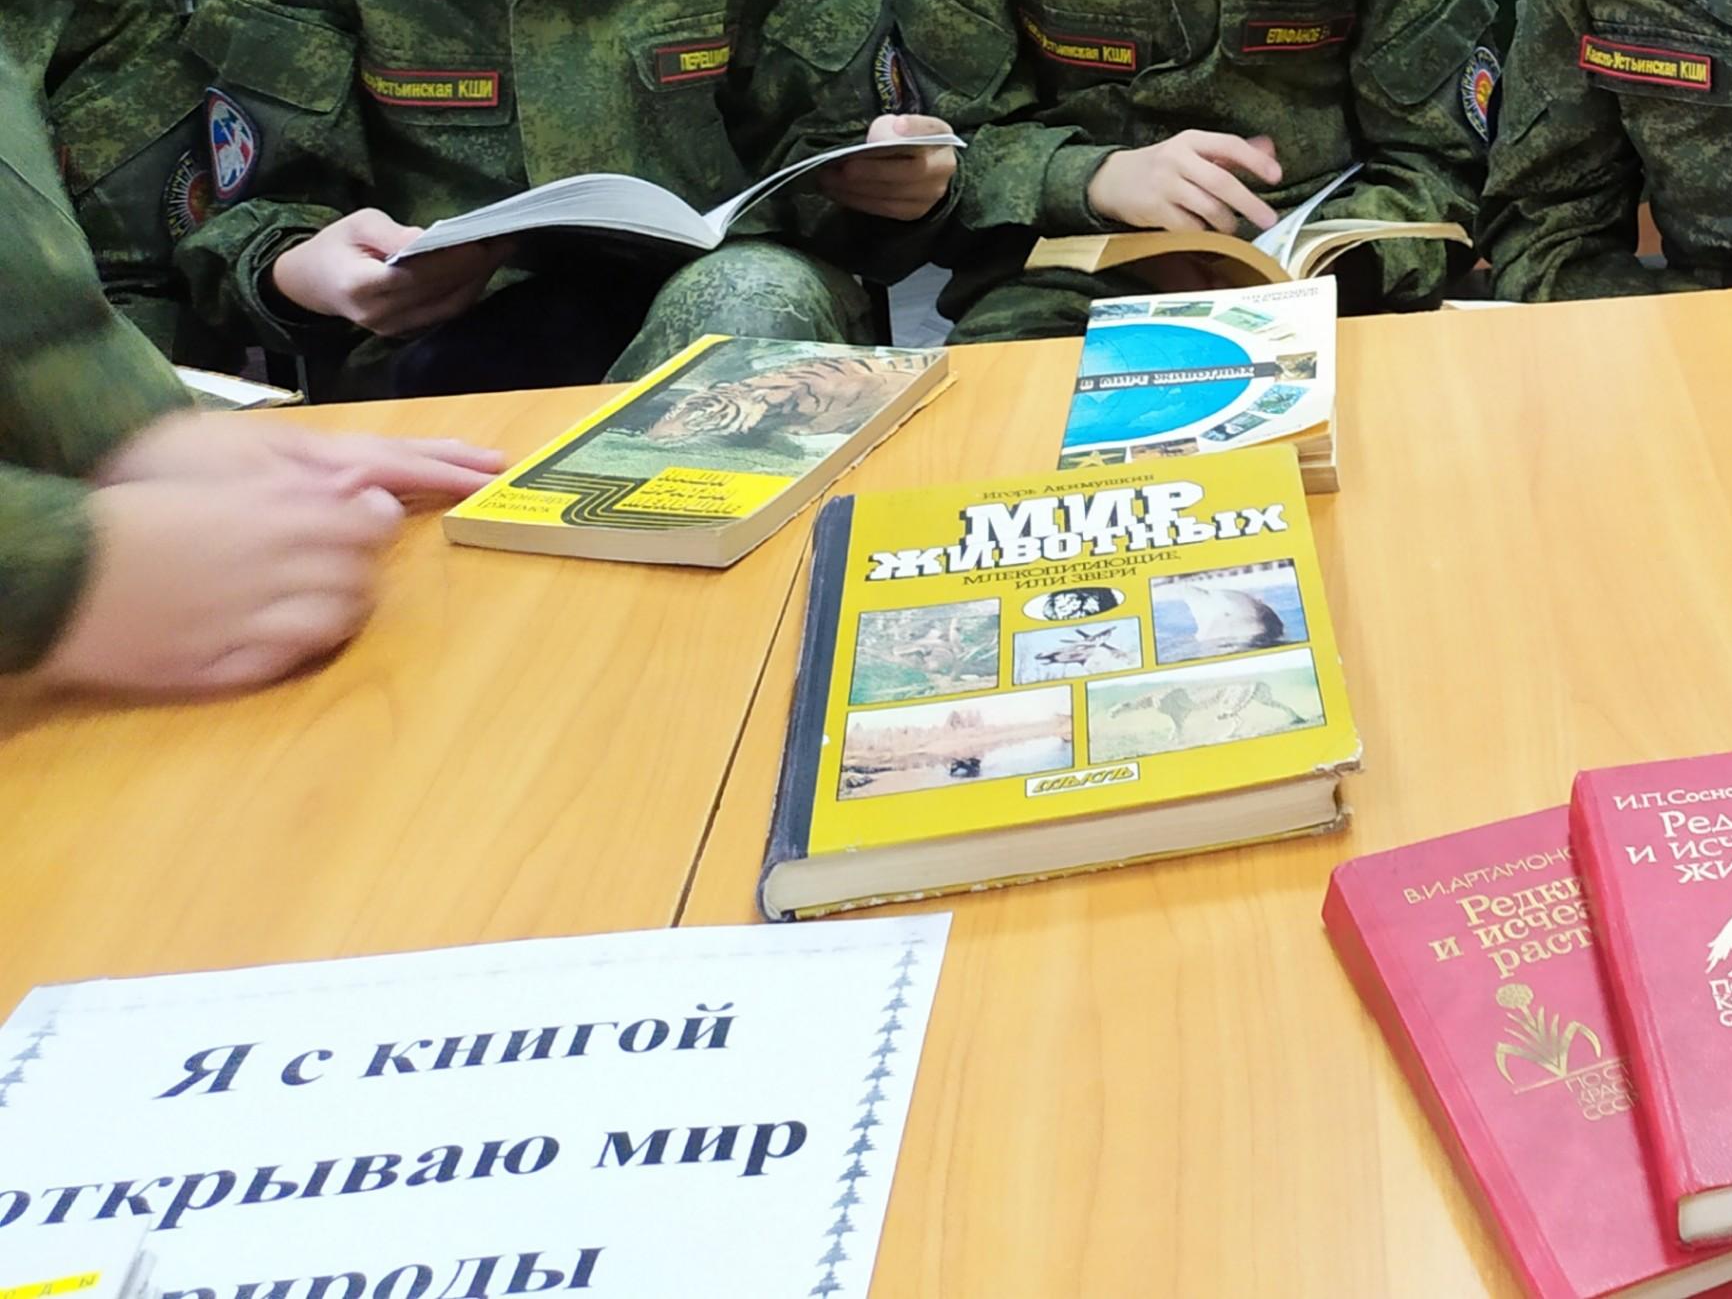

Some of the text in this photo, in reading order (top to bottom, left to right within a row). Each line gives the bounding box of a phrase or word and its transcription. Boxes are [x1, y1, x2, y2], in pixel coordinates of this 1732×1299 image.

[1102, 44, 1133, 66] КШИ
[1679, 58, 1707, 82] КШИ
[458, 78, 494, 99] КШИ
[1079, 364, 1256, 392] В МИРЕ ЖИВОТНЫХ
[981, 472, 1156, 501] Игорь Акимушкин
[960, 480, 1204, 547] МИР
[864, 503, 1290, 582] ЖИВОТНЫХ
[1014, 566, 1140, 591] ИЛИ ЗВЕРИ
[1625, 843, 1657, 866] и
[1428, 937, 1463, 963] и
[1486, 926, 1593, 979] раст
[152, 1000, 740, 1100] Я с книгой
[1575, 1082, 1635, 1108] КРАС
[0, 1118, 809, 1233] открываю мир
[150, 1246, 607, 1299] рироды
